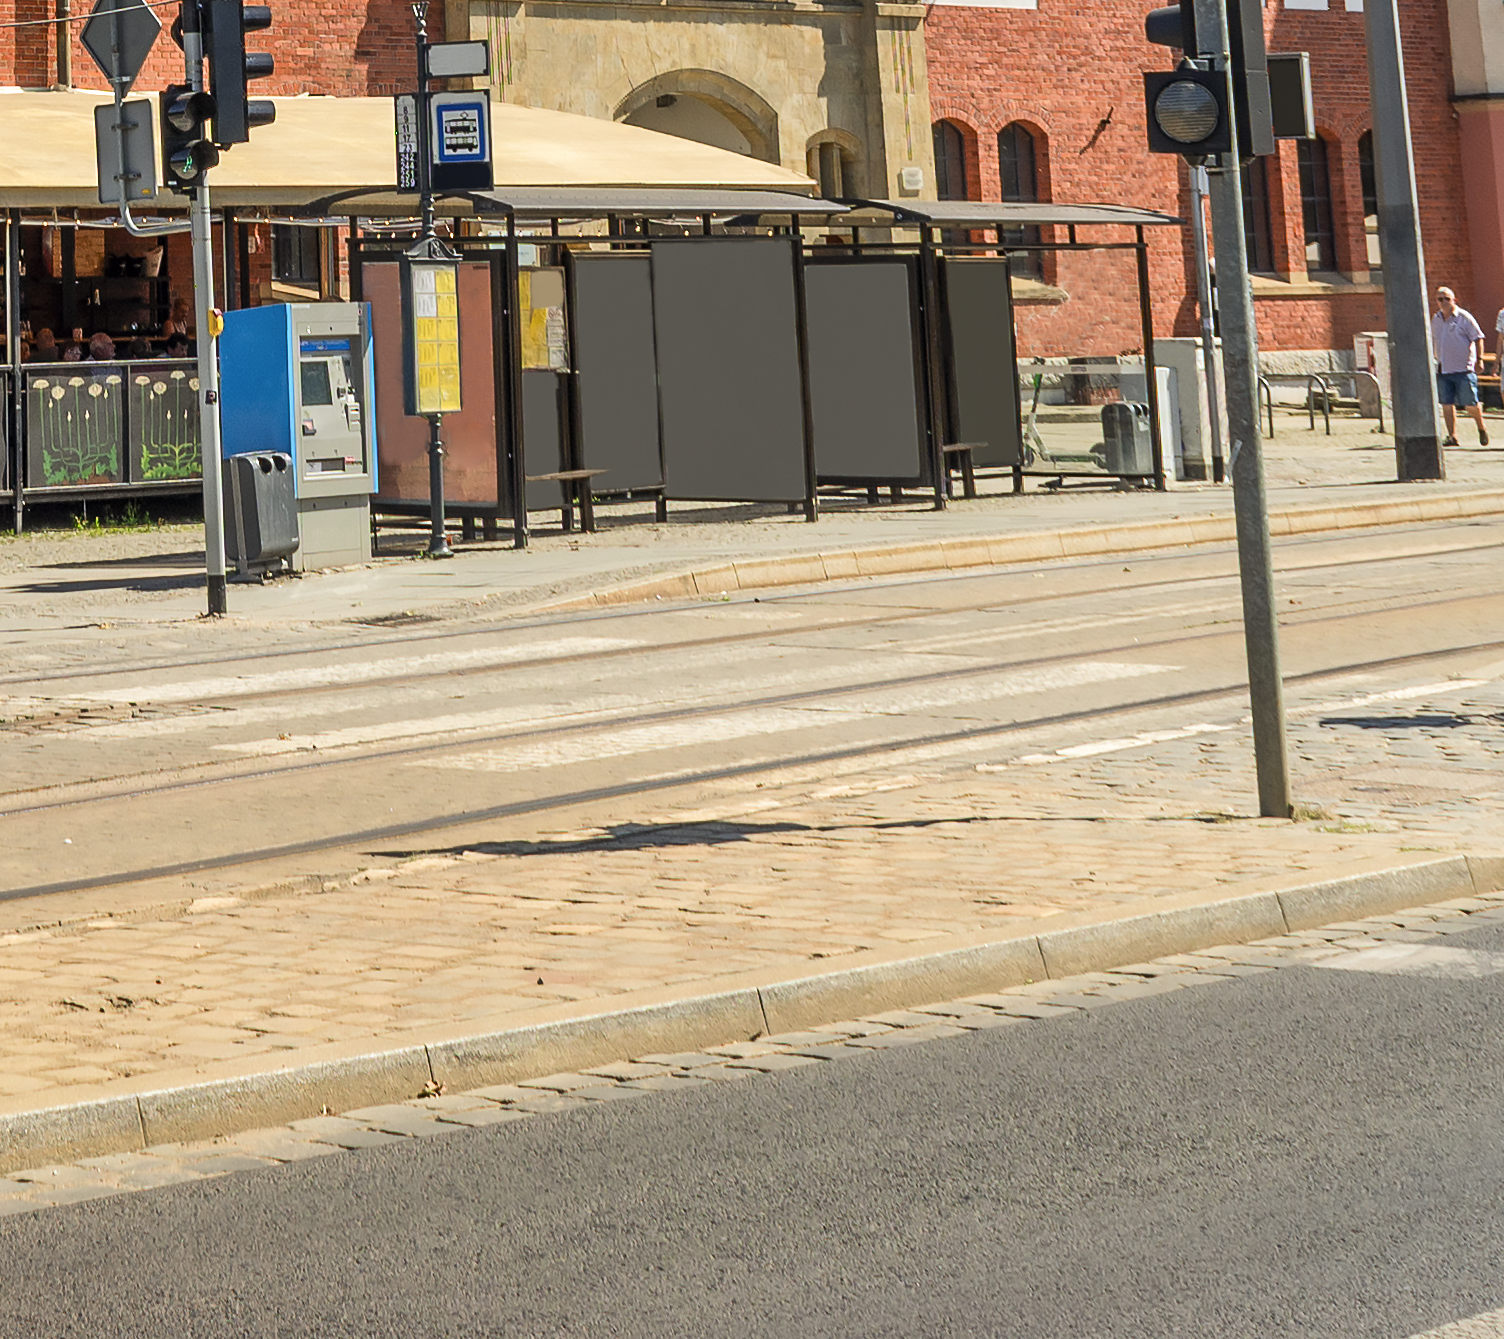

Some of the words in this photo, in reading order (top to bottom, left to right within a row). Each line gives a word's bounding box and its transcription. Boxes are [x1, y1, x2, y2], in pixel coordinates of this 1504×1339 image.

[403, 105, 409, 115] 8
[403, 115, 409, 124] 9
[403, 124, 410, 133] 11
[403, 134, 411, 143] 17
